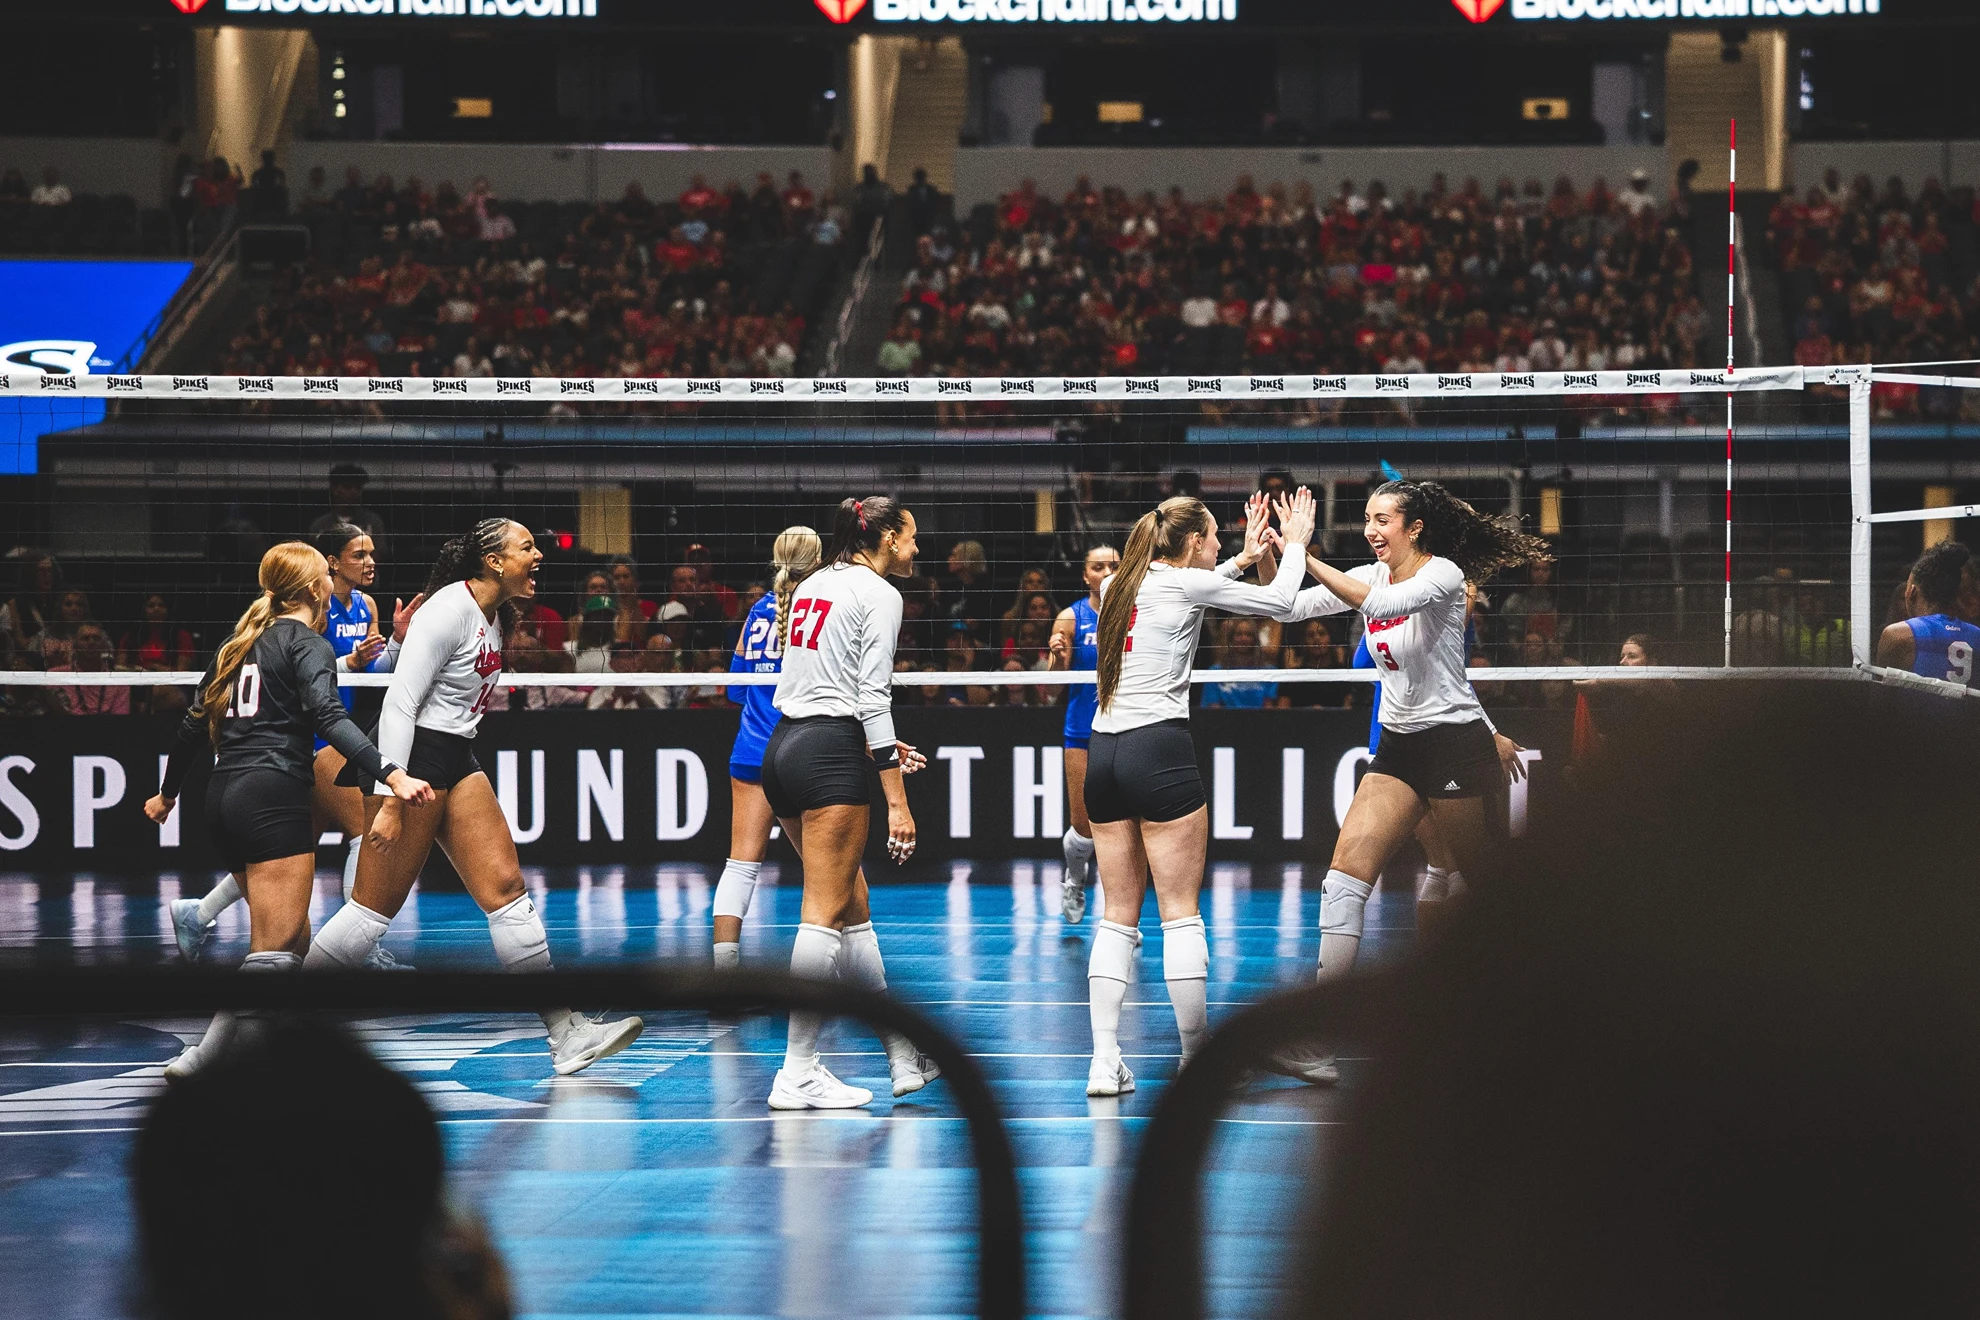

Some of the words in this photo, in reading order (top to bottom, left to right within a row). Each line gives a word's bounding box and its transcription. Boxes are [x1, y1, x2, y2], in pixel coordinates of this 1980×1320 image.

[41, 375, 76, 388] SPIKES
[107, 376, 142, 389] SPIKES
[173, 377, 208, 390] SPIKES
[239, 378, 273, 391] SPIKES
[304, 379, 338, 392] SPIKES
[369, 379, 402, 392] SPIKES
[433, 380, 466, 393] SPIKES
[497, 380, 530, 393] SPIKES
[561, 380, 594, 393] SPIKES
[625, 380, 657, 393] SPIKES
[688, 381, 720, 394] SPIKES
[751, 381, 783, 394] SPIKES
[814, 381, 846, 394] SPIKES
[876, 380, 908, 393] SPIKES
[939, 381, 971, 394] SPIKES
[1001, 380, 1034, 393] SPIKES
[1064, 380, 1096, 393] SPIKES
[1126, 379, 1158, 392] SPIKES
[1188, 378, 1221, 391] SPIKES
[1251, 378, 1283, 391] SPIKES
[1313, 377, 1346, 390] SPIKES
[1376, 377, 1408, 390] SPIKES
[1439, 375, 1471, 388] SPIKES
[1501, 375, 1534, 388] SPIKES
[1564, 373, 1597, 386] SPIKES
[1627, 372, 1660, 385] SPIKES
[1691, 372, 1724, 385] SPIKES
[745, 618, 783, 660] 20
[790, 598, 833, 651] 27
[755, 662, 776, 673] PARKS
[1376, 642, 1399, 670] 3
[1946, 641, 1973, 684] 9
[226, 663, 260, 718] 0
[497, 748, 781, 844] UND
[936, 746, 1063, 838] TH
